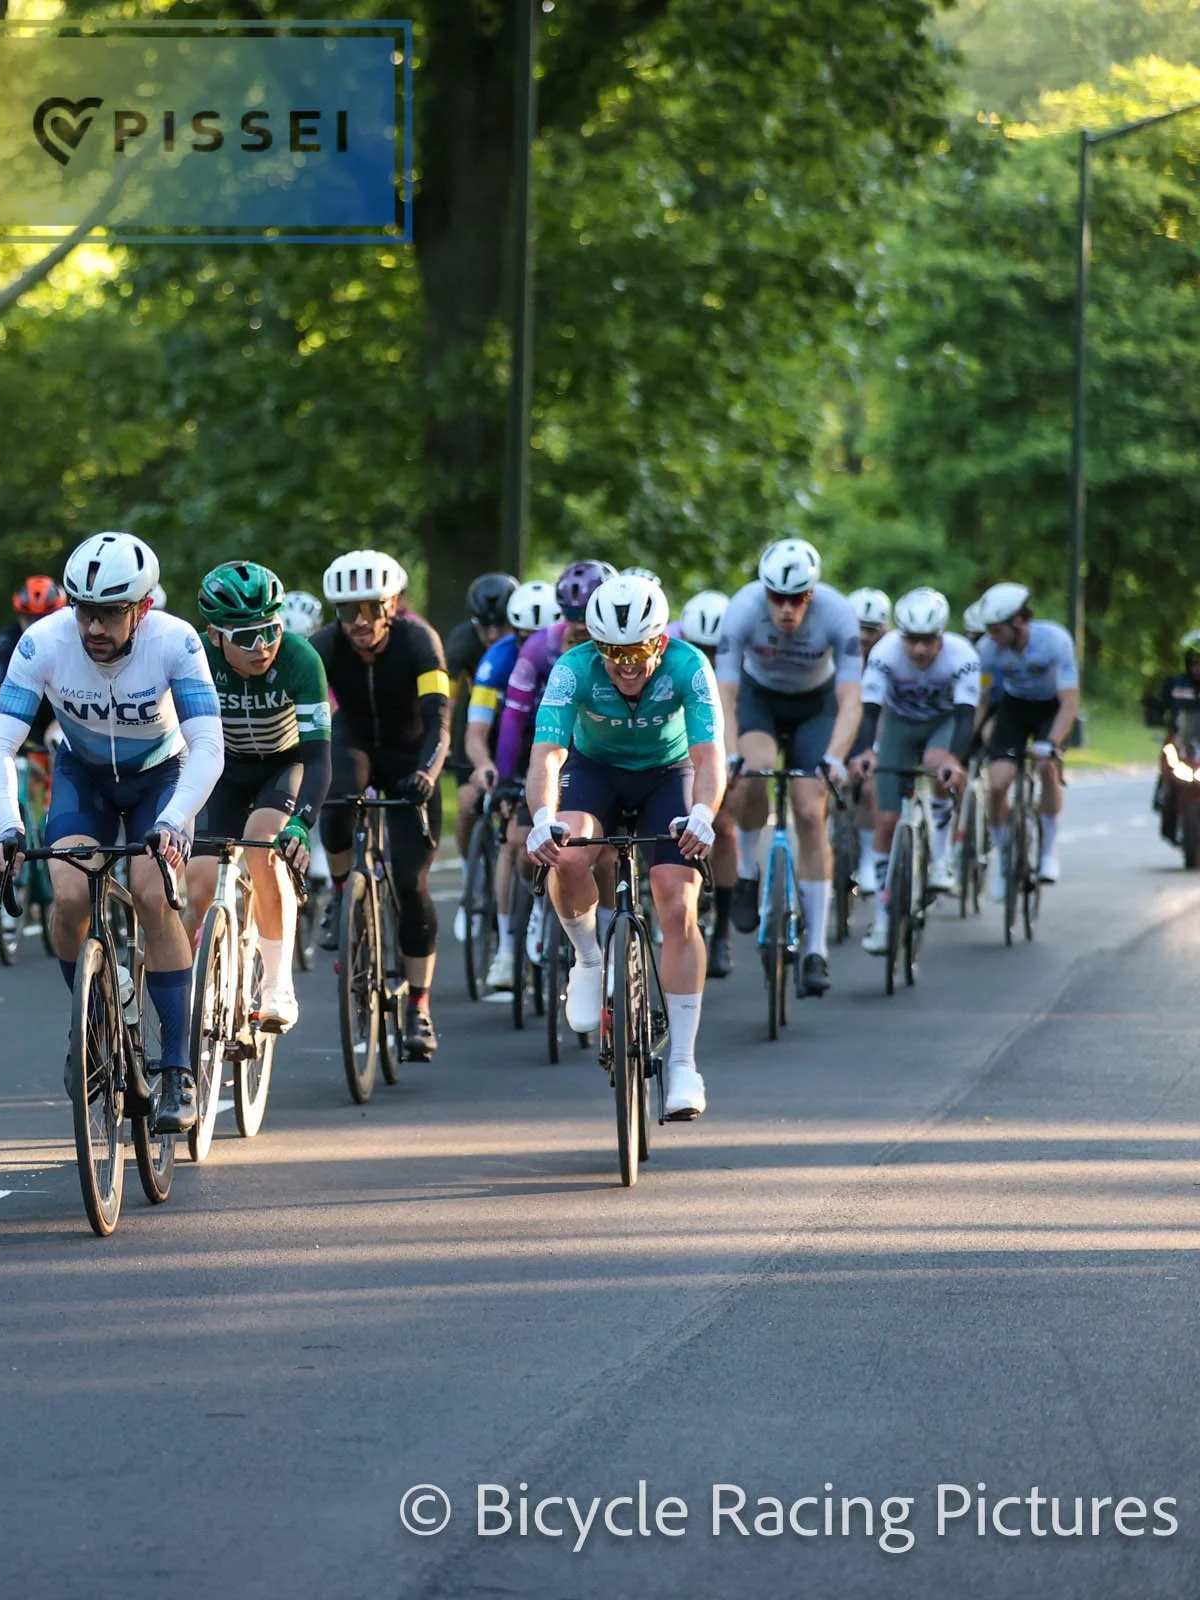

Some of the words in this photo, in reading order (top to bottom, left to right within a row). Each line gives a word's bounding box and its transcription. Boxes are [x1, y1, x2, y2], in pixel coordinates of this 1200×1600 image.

[60, 686, 102, 700] MAGEN
[217, 689, 294, 709] ESELKA
[63, 700, 161, 721] NYCC
